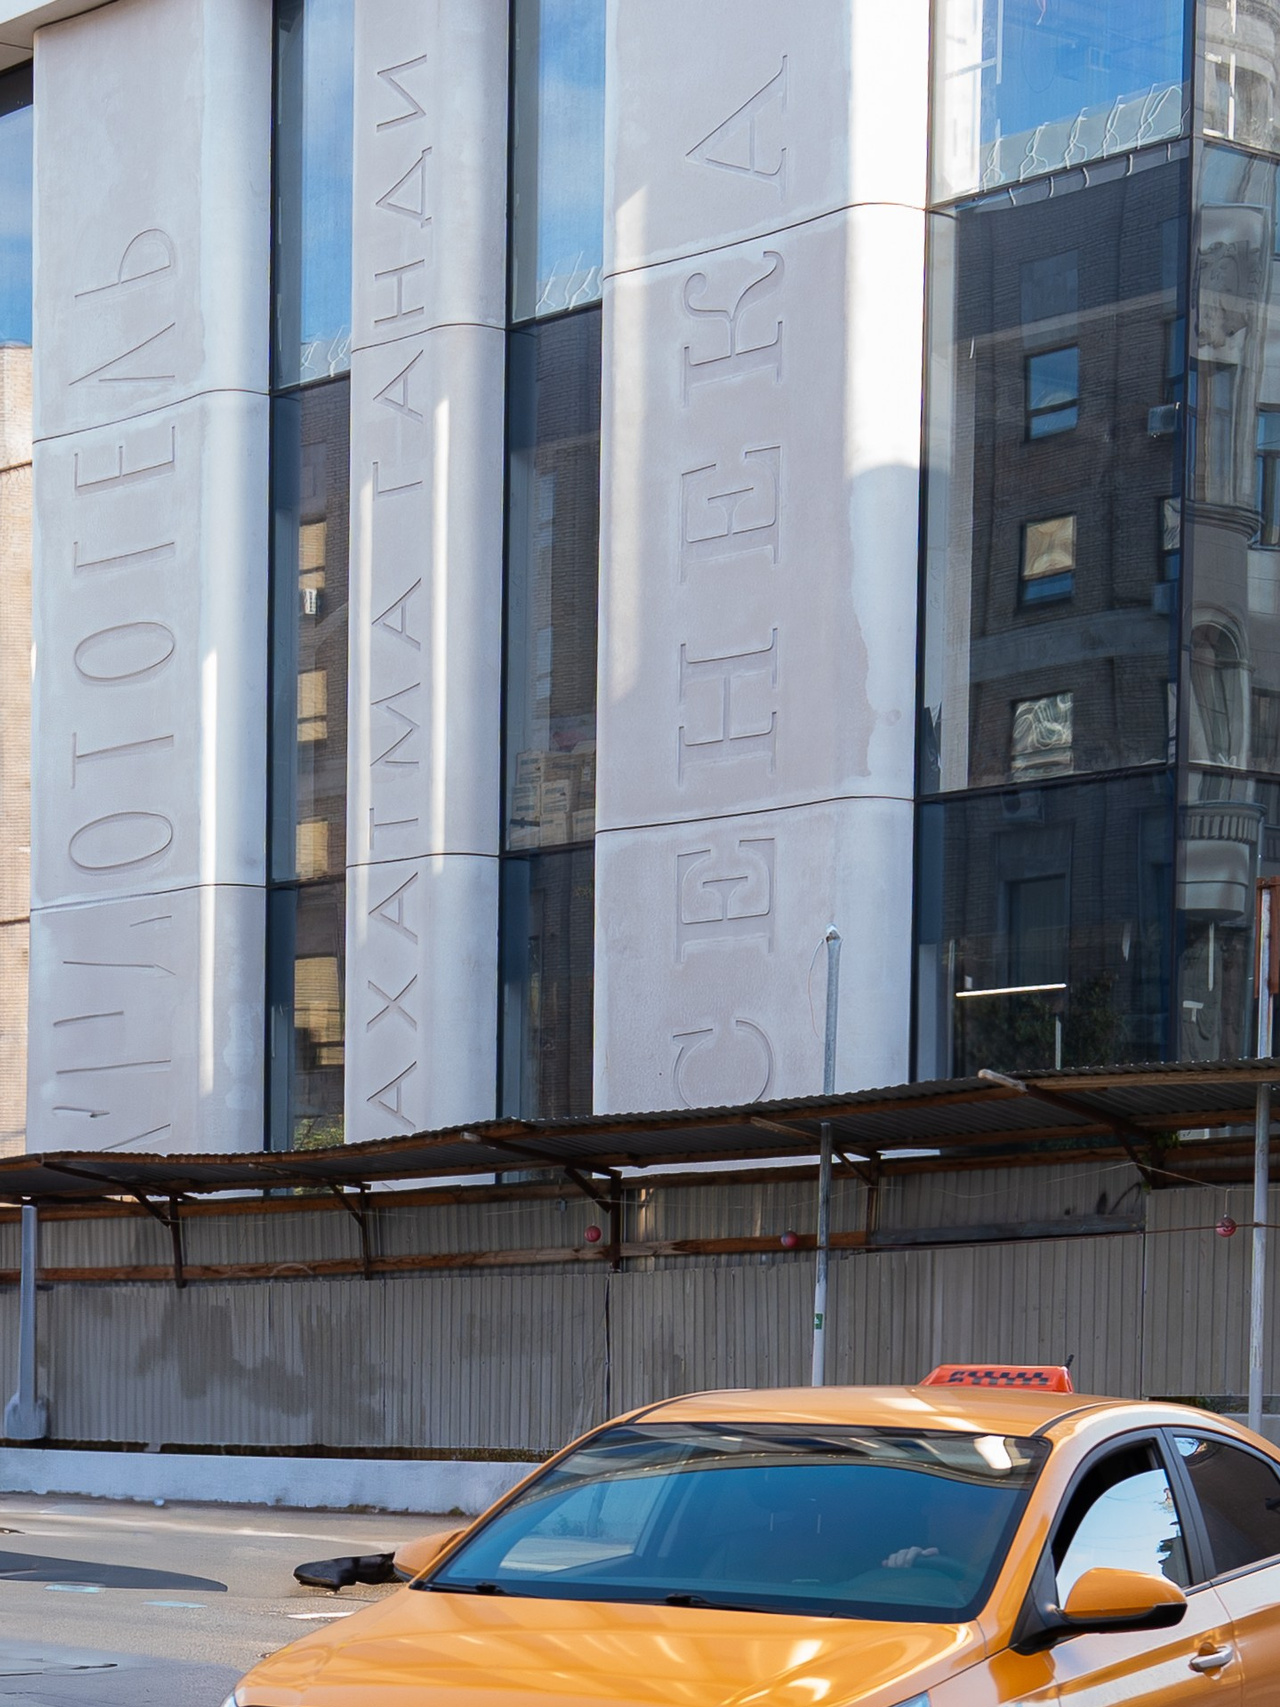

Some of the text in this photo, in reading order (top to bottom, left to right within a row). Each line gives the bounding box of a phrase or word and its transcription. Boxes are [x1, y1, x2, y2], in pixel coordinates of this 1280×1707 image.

[365, 51, 432, 1131] АХАТМА ГАНДИ
[671, 51, 791, 1107] СЕНЕКА
